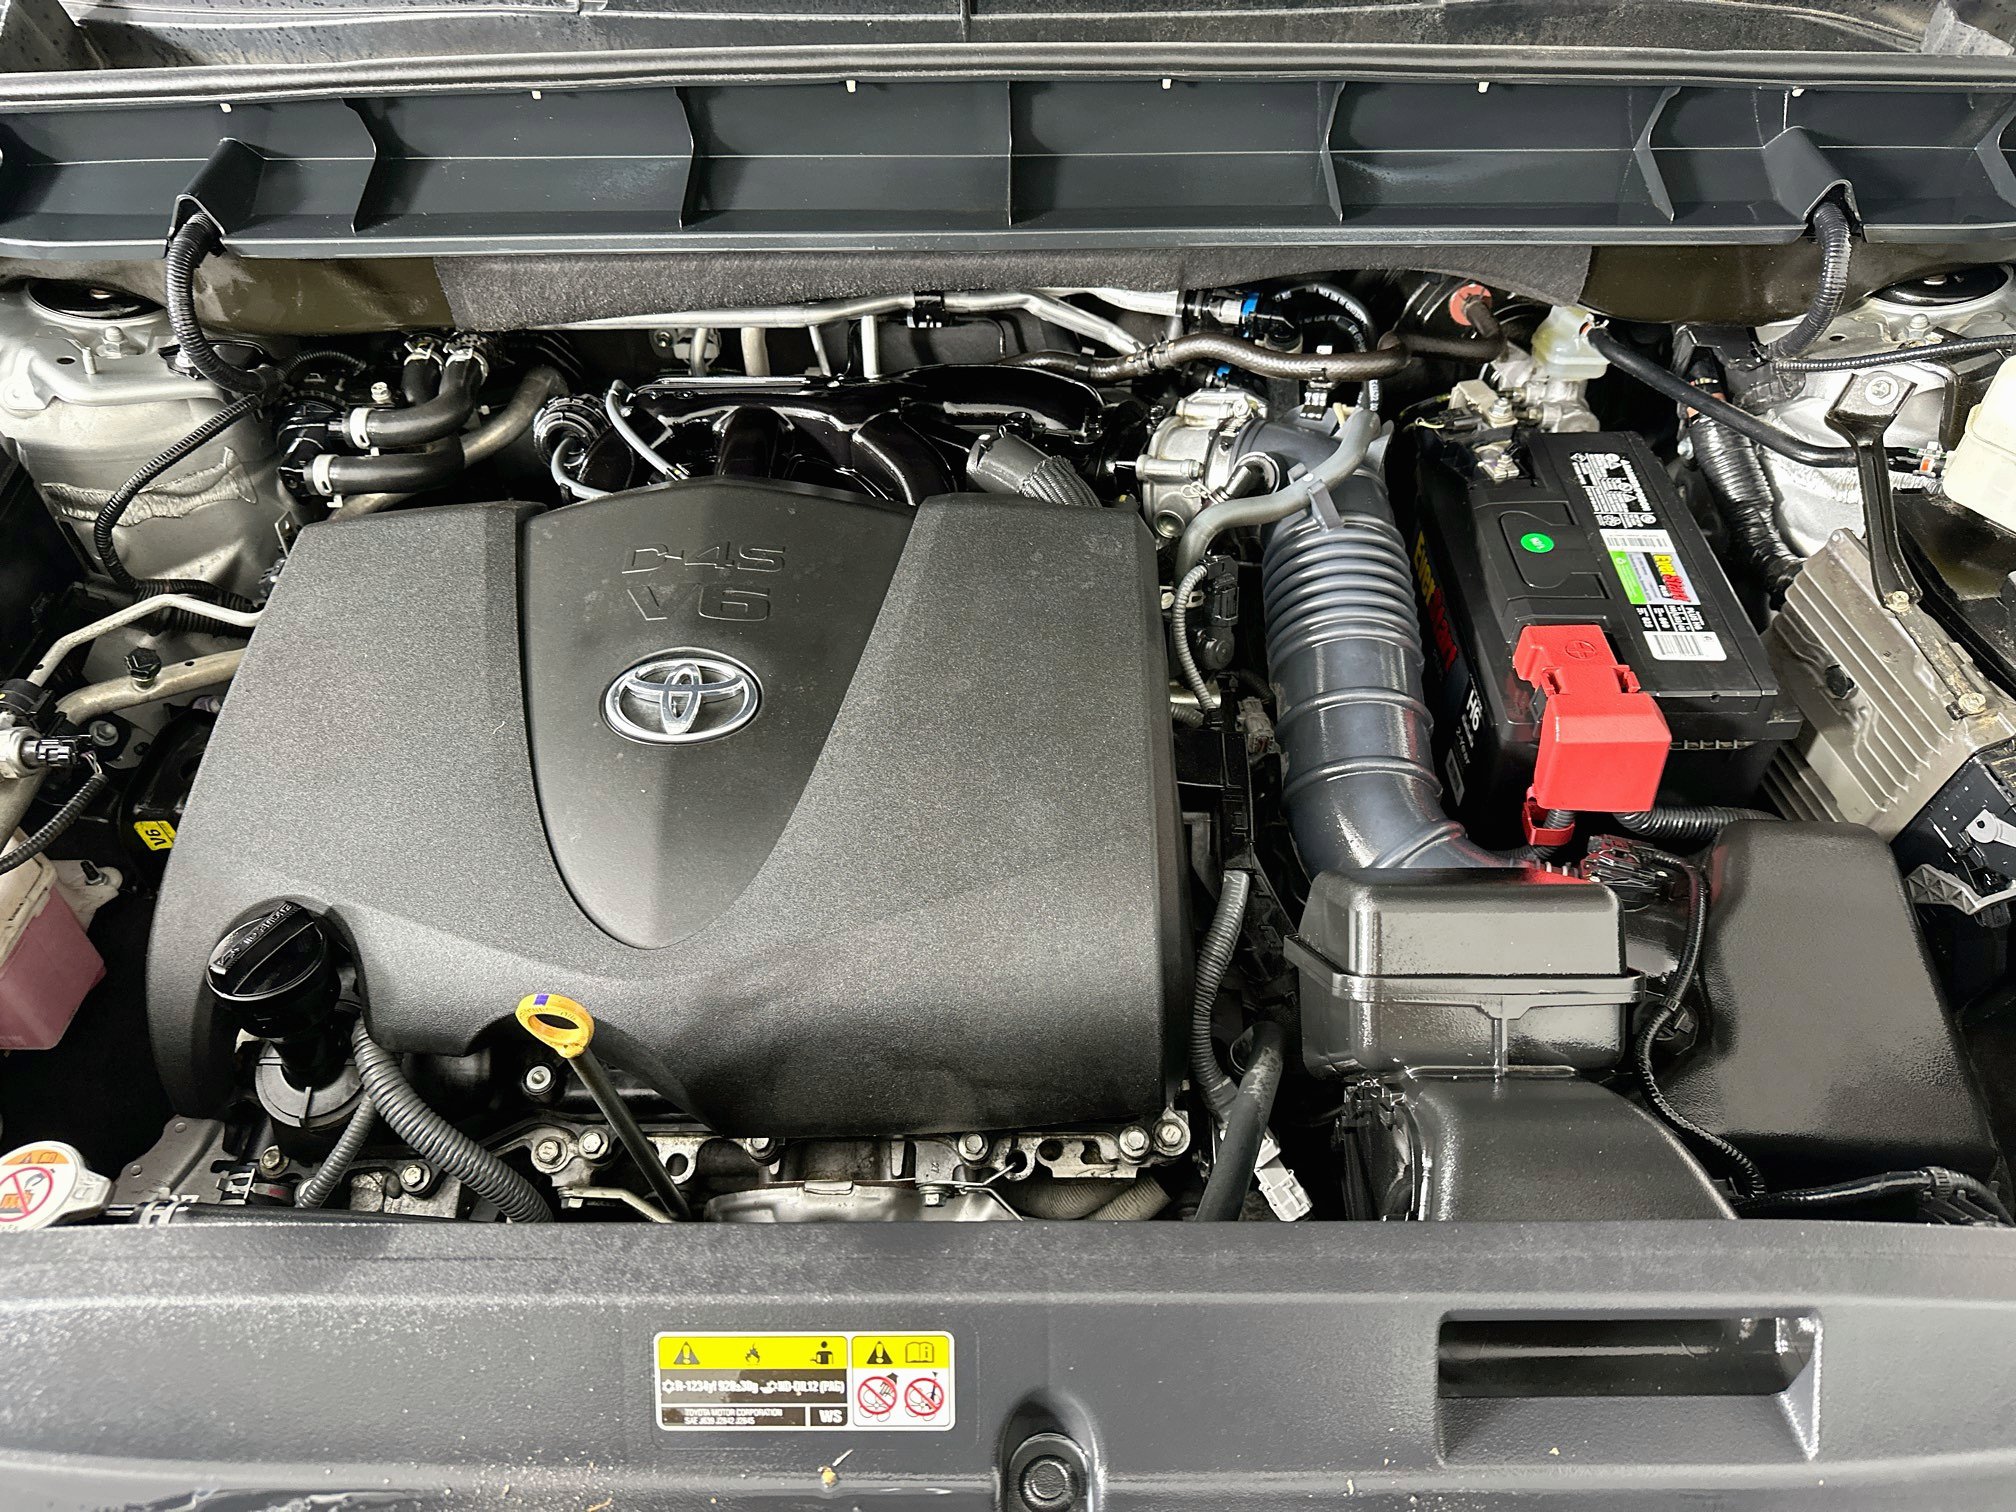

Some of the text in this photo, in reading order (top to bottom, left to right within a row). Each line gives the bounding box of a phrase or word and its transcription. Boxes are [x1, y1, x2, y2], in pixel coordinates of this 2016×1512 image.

[1653, 554, 1692, 603] EverStart
[626, 583, 771, 622] V6
[1466, 690, 1484, 731] H6
[145, 829, 167, 846] V6
[684, 1408, 783, 1417] TOYOTA MOTOR CORPORATION
[684, 1416, 699, 1425] SAE
[819, 1409, 843, 1424] WS
